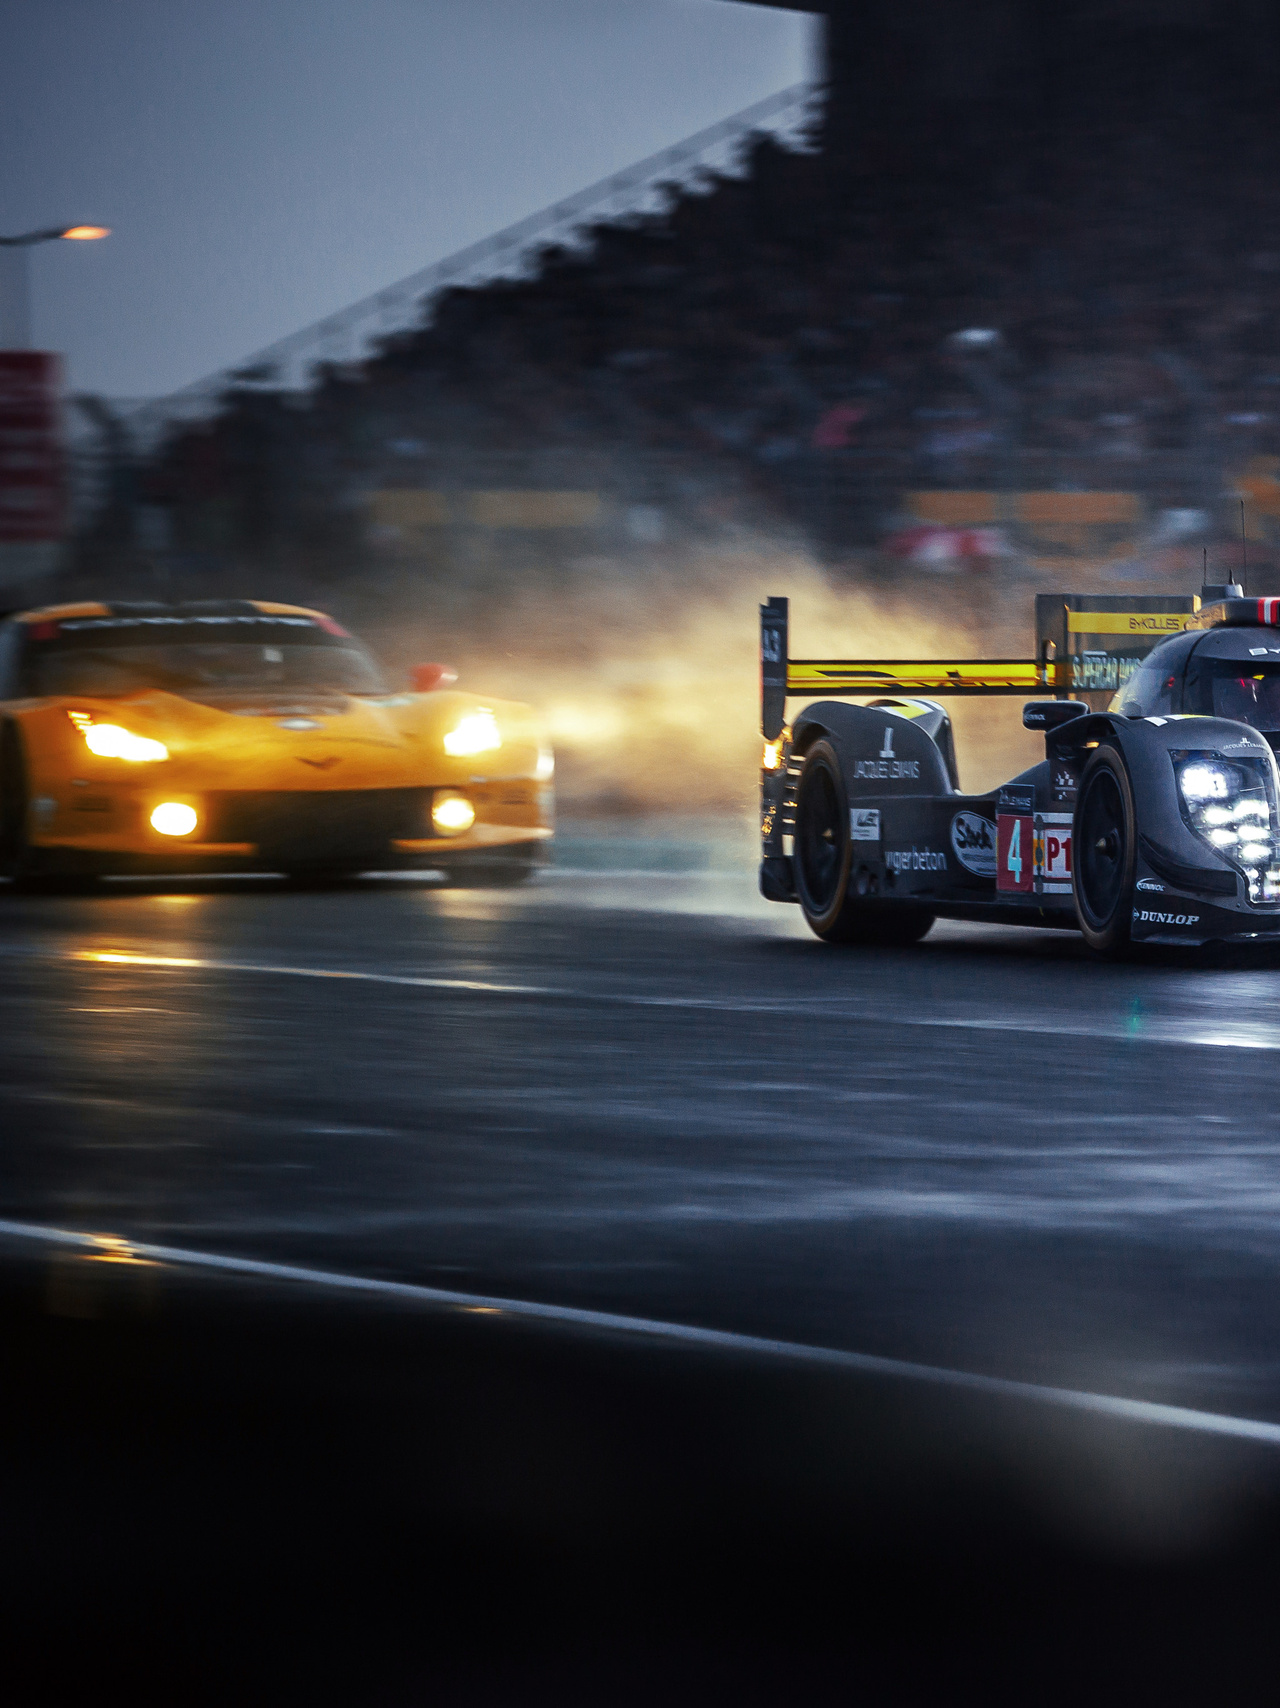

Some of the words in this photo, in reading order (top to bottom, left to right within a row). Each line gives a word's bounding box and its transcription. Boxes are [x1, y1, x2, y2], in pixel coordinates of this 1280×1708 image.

[1007, 819, 1023, 884] 4
[1046, 836, 1073, 873] P1
[1139, 910, 1201, 926] DUNLOP
